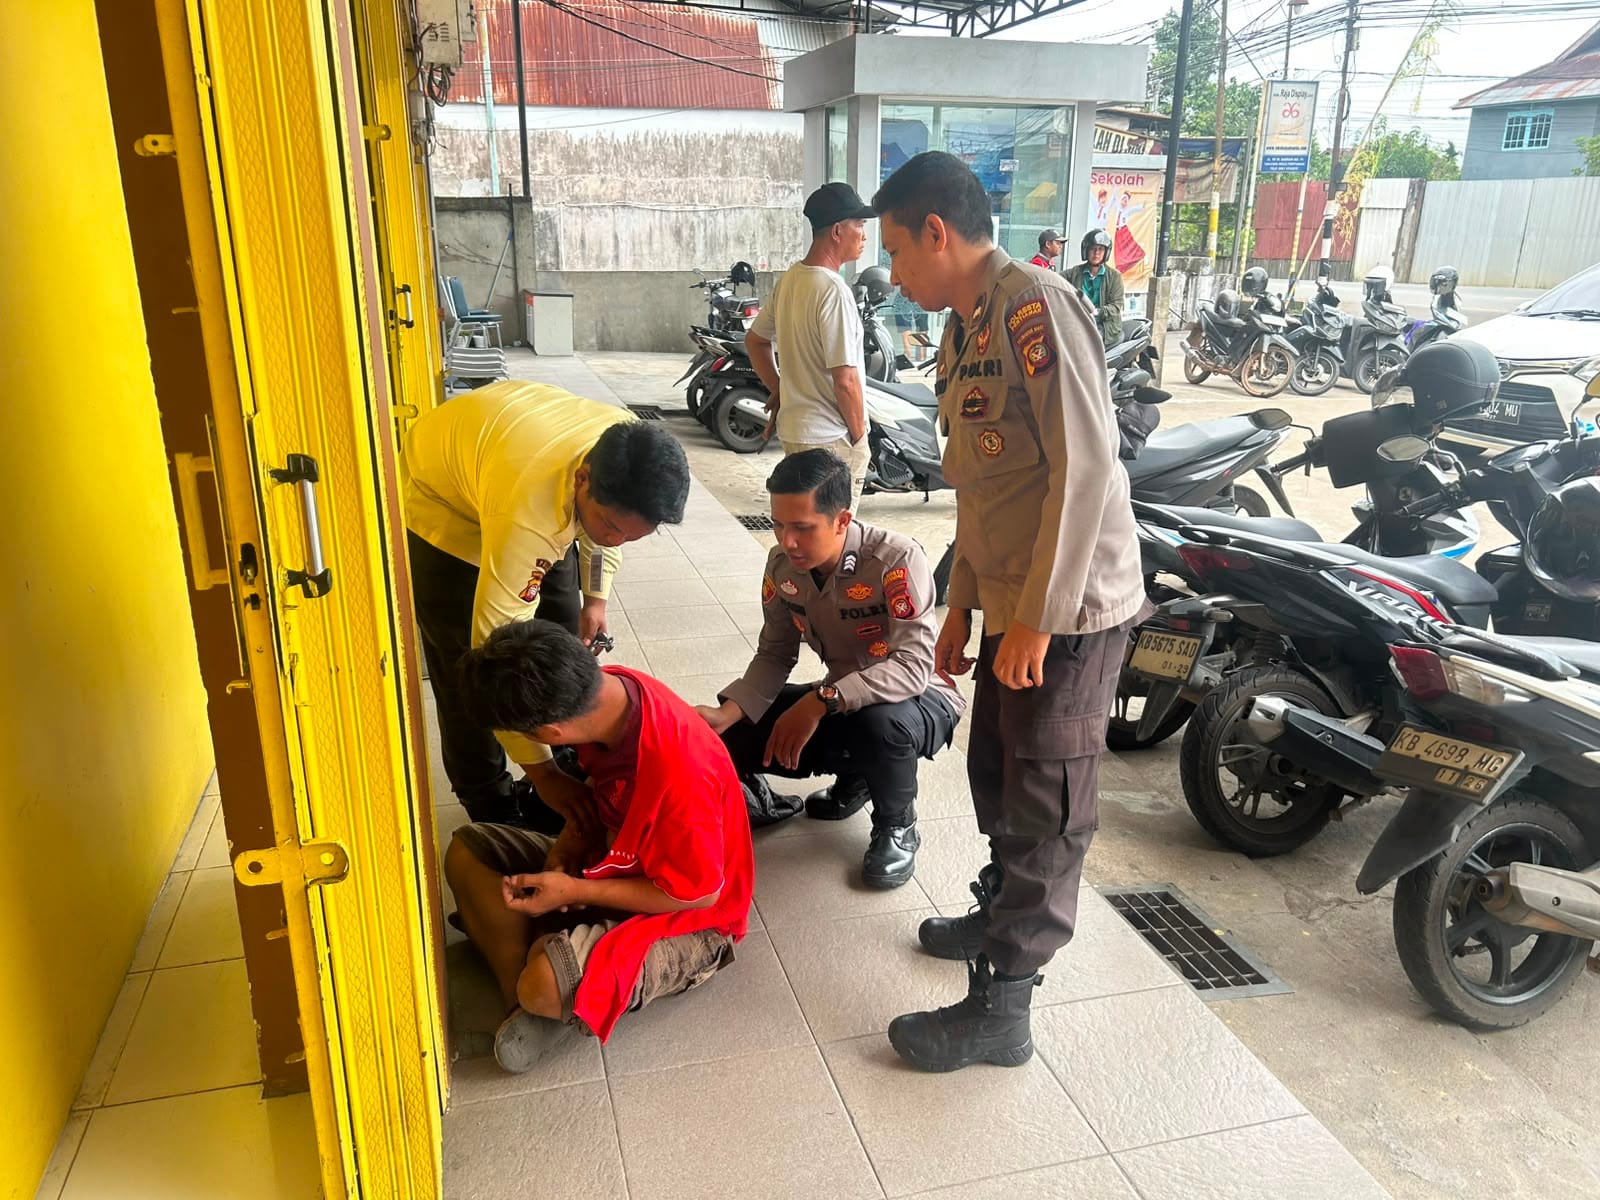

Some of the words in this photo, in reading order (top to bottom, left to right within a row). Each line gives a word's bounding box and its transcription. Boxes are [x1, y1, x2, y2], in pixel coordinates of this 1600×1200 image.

[1090, 172, 1144, 186] Sekolah
[960, 359, 1003, 380] POLRI
[839, 603, 888, 620] POLRI
[1395, 731, 1420, 751] KB
[1424, 740, 1470, 763] 4698
[1473, 753, 1504, 774] MG
